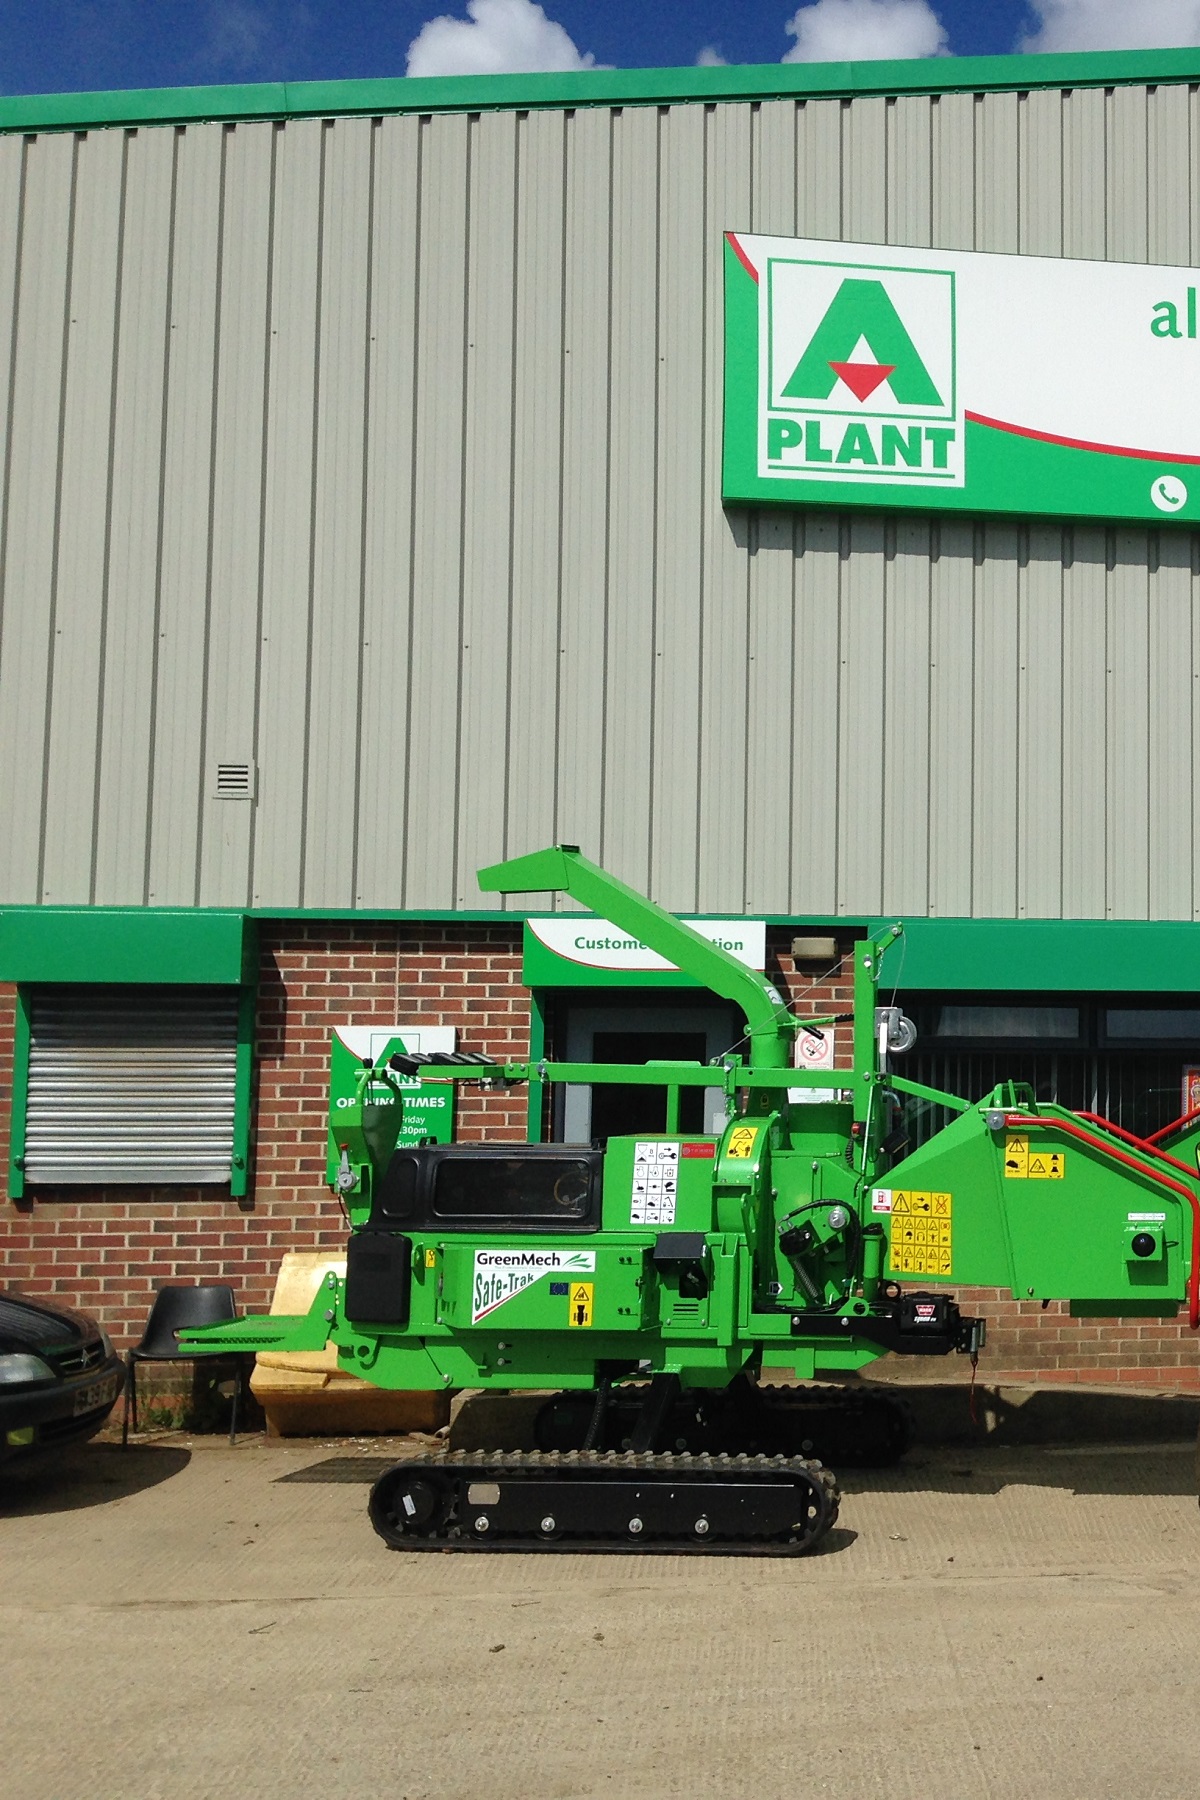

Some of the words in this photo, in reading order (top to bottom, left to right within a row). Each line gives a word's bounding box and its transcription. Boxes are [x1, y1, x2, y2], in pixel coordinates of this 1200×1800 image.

[781, 278, 944, 407] A
[767, 417, 957, 469] PLANT
[574, 937, 648, 950] Custome
[404, 1097, 446, 1108] TIMES
[399, 1125, 428, 1136] .30pm
[477, 1252, 561, 1266] GreenMech
[475, 1272, 534, 1311] Safe-Trak
